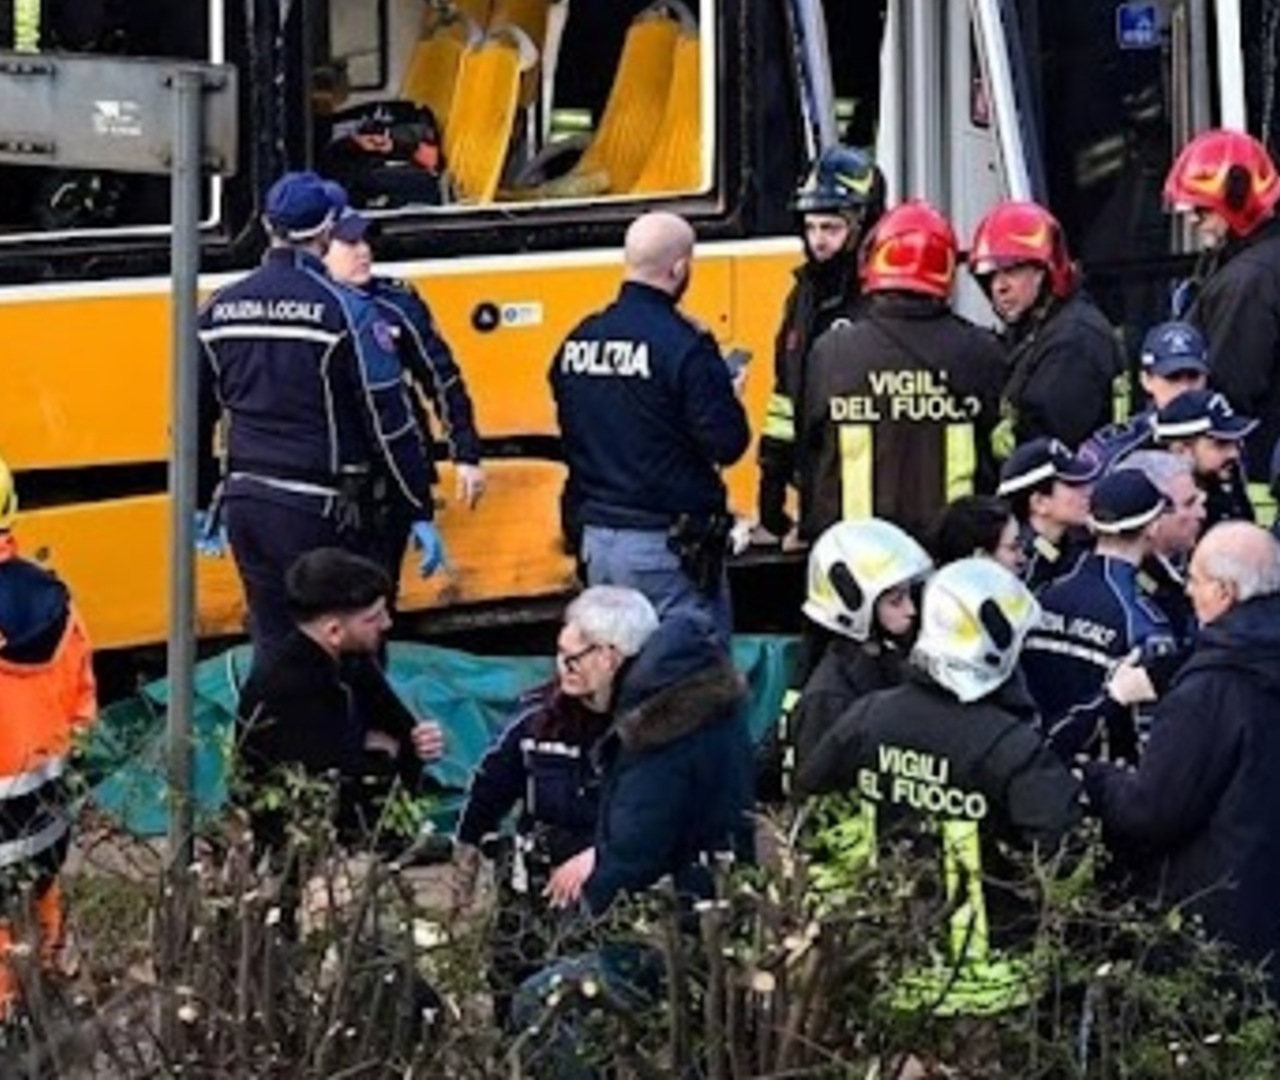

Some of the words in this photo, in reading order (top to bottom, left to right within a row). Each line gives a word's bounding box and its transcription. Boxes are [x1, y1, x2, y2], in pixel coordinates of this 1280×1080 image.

[561, 340, 651, 380] POLIZIA
[830, 396, 881, 421] DEL
[878, 743, 949, 785] VIGILI
[893, 776, 989, 820] FUOCO
